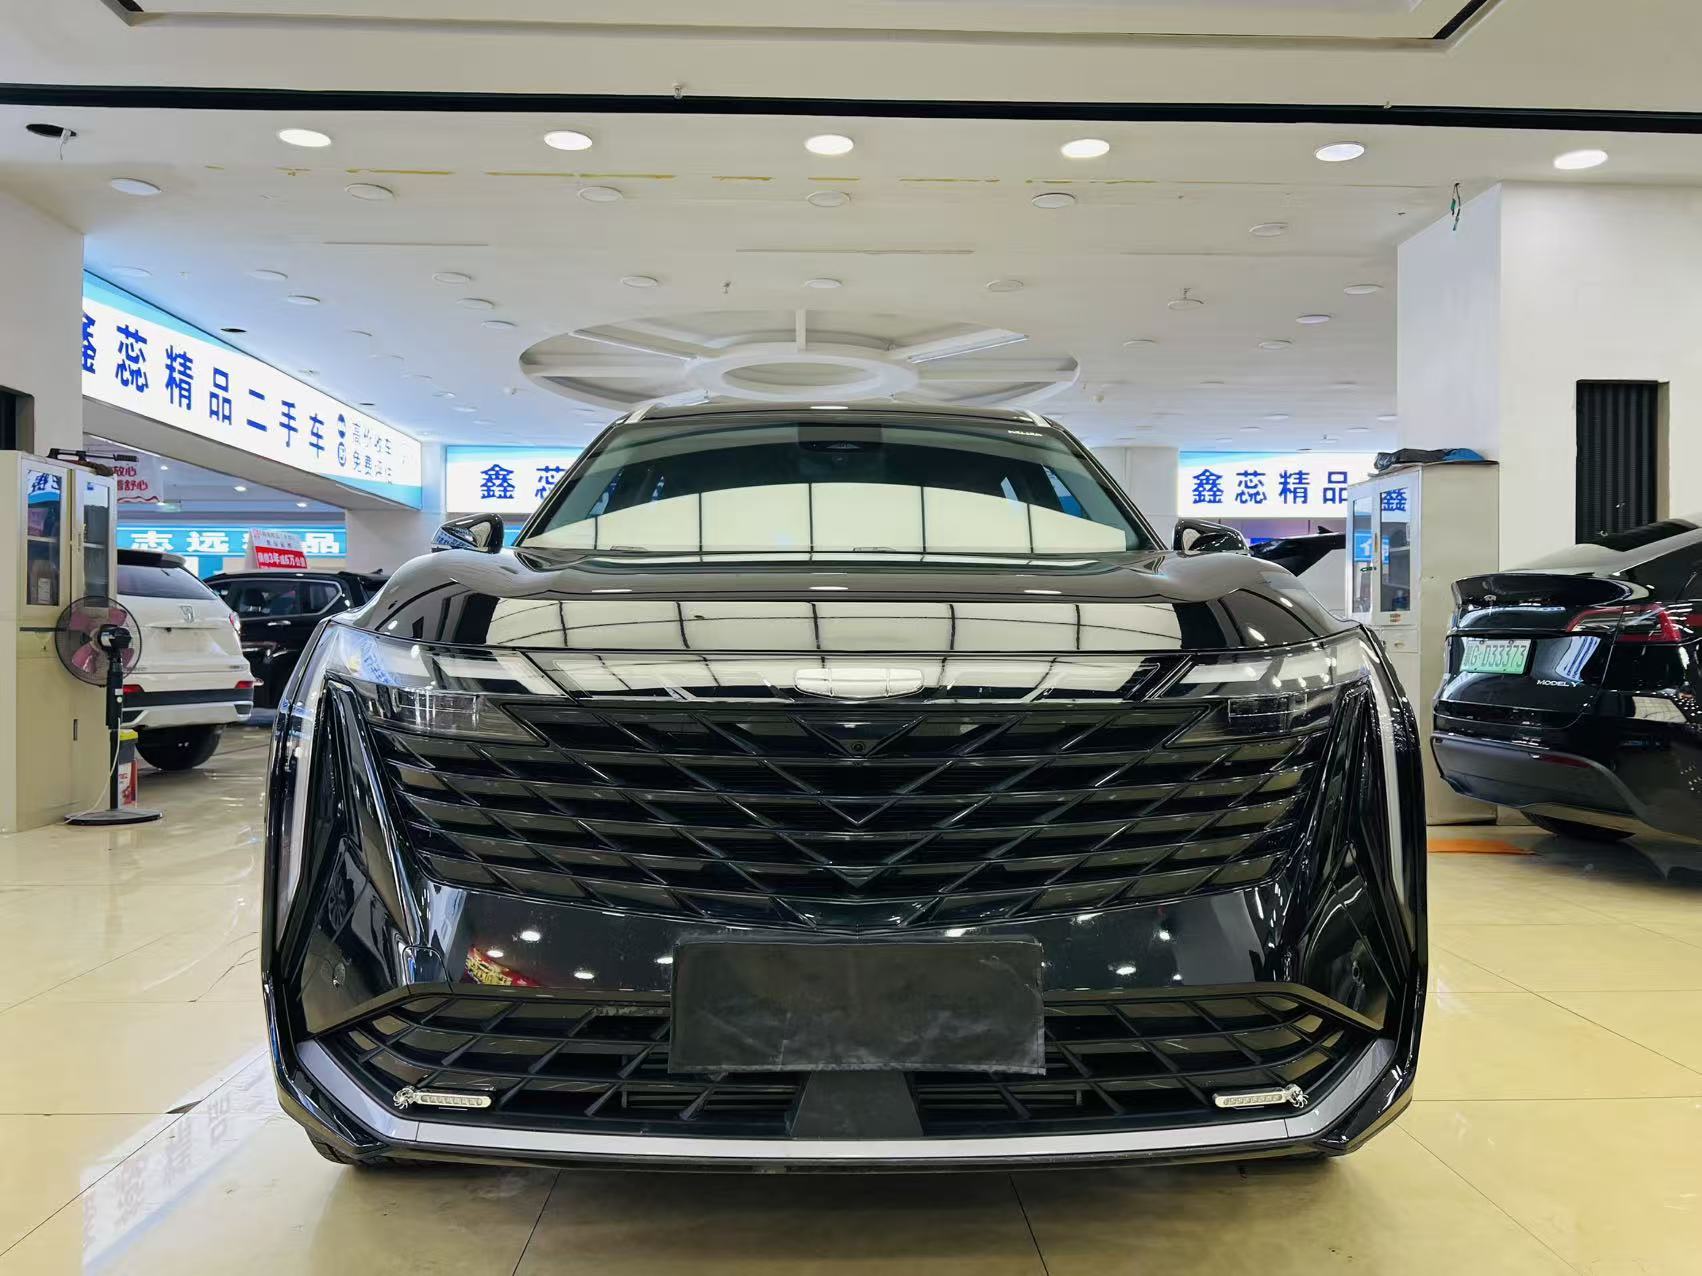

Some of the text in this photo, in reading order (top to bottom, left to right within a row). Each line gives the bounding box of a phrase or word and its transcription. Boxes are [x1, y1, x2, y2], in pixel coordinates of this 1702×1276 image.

[1192, 469, 1347, 504] 鑫蕊精品
[131, 531, 340, 553] 志远品
